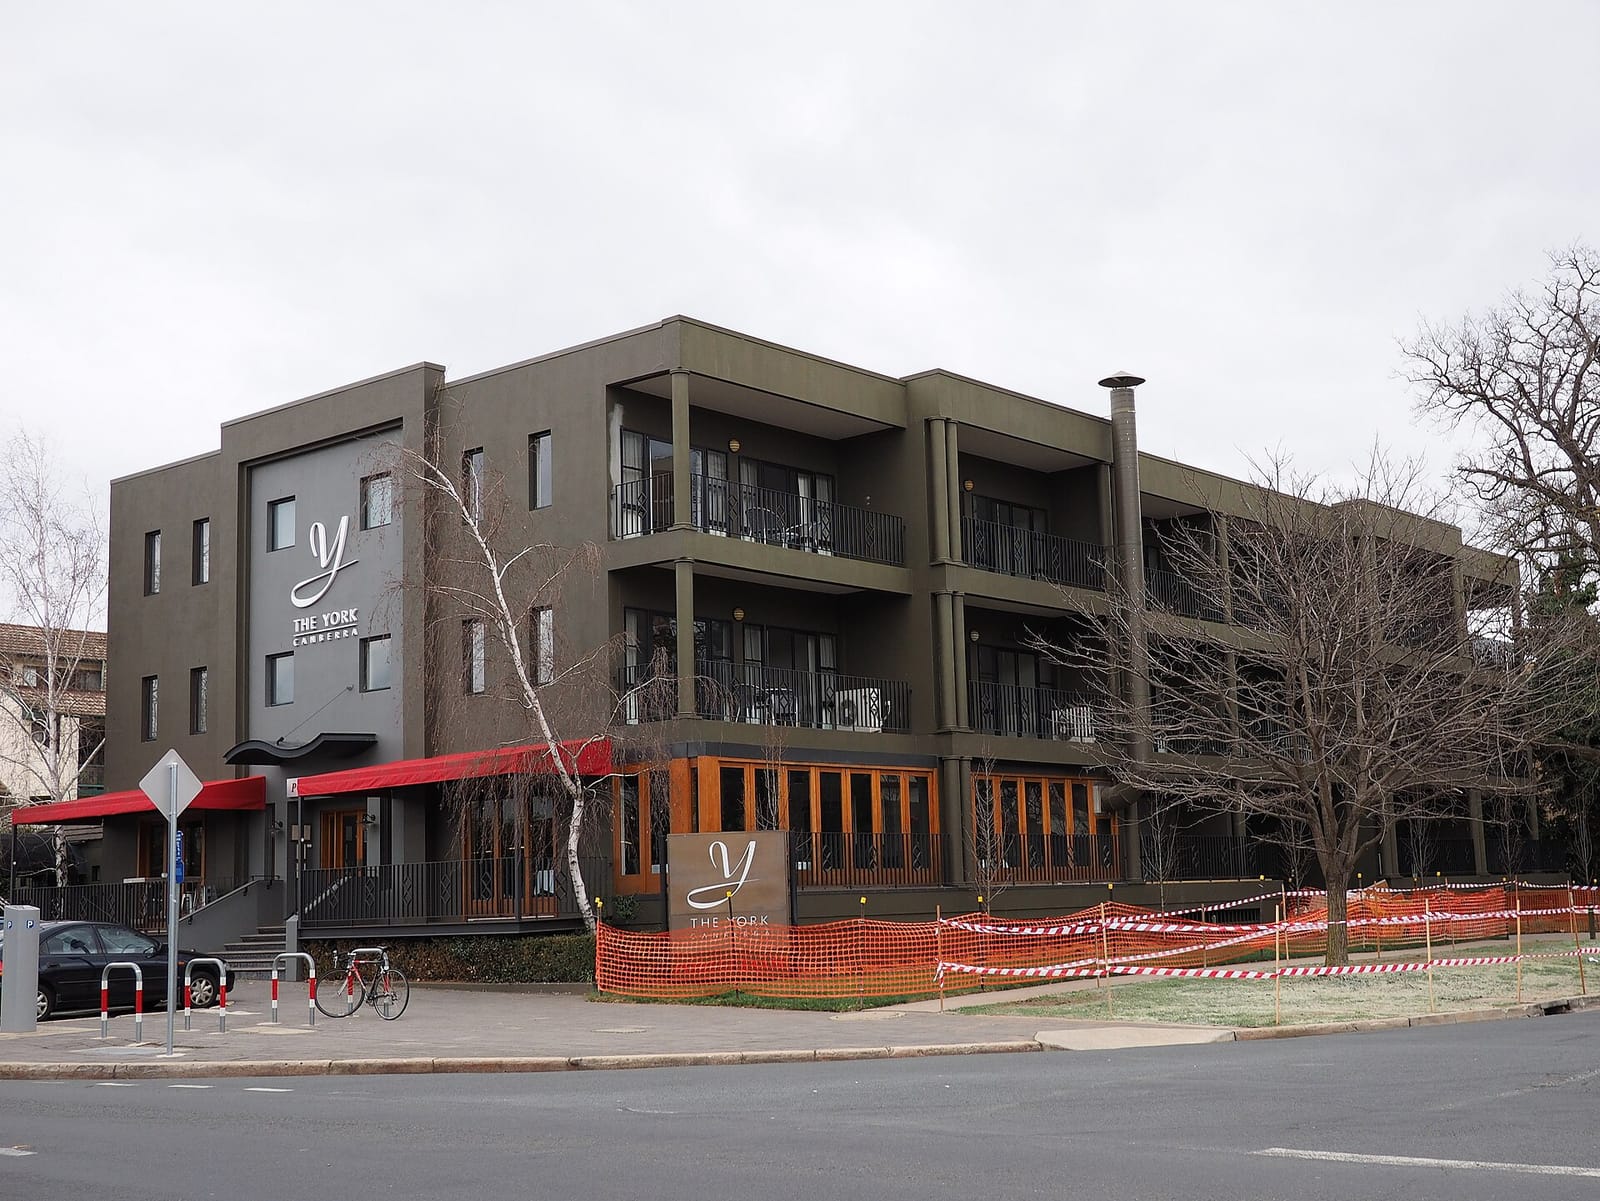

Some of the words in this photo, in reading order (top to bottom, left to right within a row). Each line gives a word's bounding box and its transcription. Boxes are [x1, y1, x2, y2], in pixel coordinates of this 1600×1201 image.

[293, 615, 317, 632] THE
[322, 608, 358, 627] YORK
[293, 628, 358, 646] CANBERRA
[690, 917, 719, 929] THE
[726, 915, 769, 928] YORK
